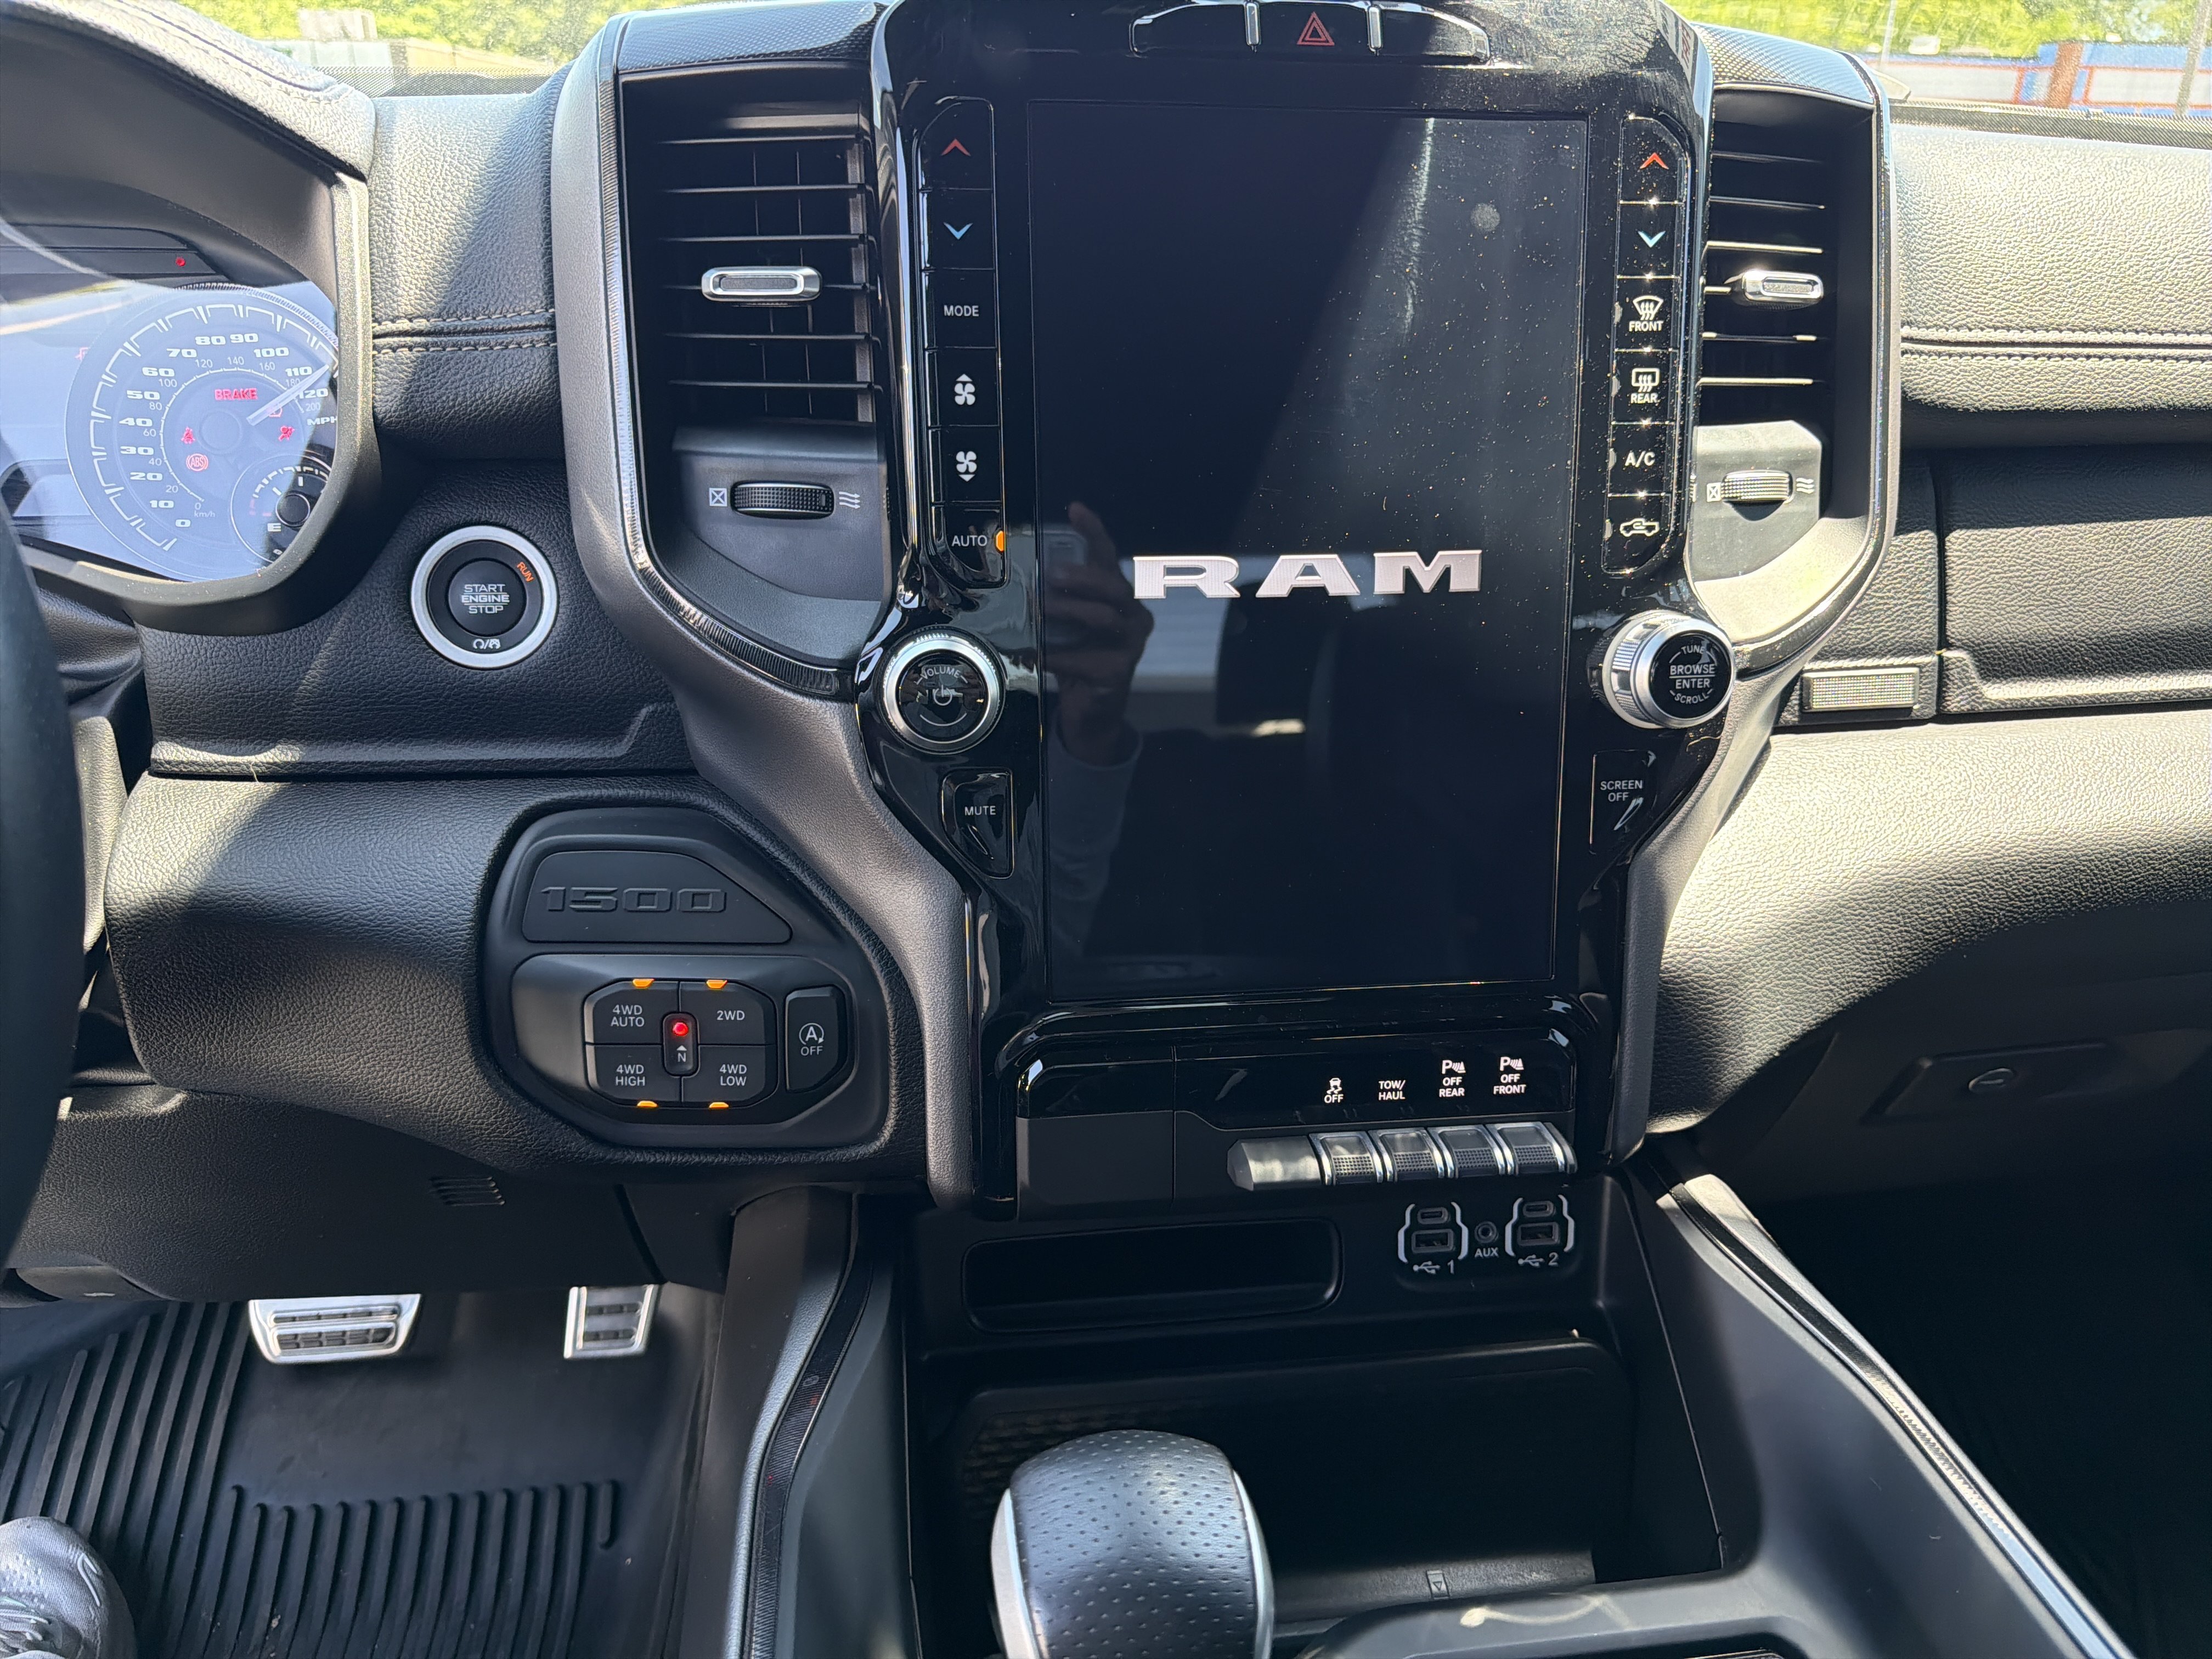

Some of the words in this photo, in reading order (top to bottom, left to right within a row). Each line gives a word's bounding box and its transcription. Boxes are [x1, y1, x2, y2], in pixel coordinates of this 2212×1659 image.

[944, 305, 979, 317] MODE
[1629, 320, 1663, 331] FRONT
[195, 336, 226, 345] 80
[230, 333, 258, 343] 90
[166, 348, 197, 358] 70
[253, 347, 289, 358] 100
[195, 359, 213, 368] 120
[228, 357, 244, 365] 140
[259, 362, 275, 371] 160
[285, 366, 312, 377] 110
[142, 367, 175, 377] 60
[159, 379, 177, 387] 100
[127, 390, 160, 400] 50
[215, 388, 258, 400] BRAKE
[1630, 393, 1658, 404] REAR
[149, 402, 162, 410] 80
[306, 403, 320, 412] 200
[119, 417, 153, 427] 40
[143, 429, 156, 437] 60
[120, 446, 154, 455] 30
[149, 458, 162, 466] 40
[191, 458, 205, 467] ABS
[1625, 451, 1655, 467] A/C
[130, 472, 162, 481] 20
[166, 485, 178, 493] 20
[149, 500, 174, 508] 10
[175, 519, 191, 527] 0
[267, 523, 281, 532] E
[952, 535, 988, 546] AUTO
[517, 562, 535, 582] RUN
[1133, 549, 1482, 599] RAM
[464, 584, 506, 592] START
[461, 594, 510, 603] ENGINE
[469, 605, 504, 614] STOP
[1681, 645, 1705, 654] TUNE
[920, 666, 961, 680] VOLUME
[1670, 664, 1715, 675] BROWSE
[1675, 678, 1710, 689] ENTER
[1674, 692, 1709, 704] SCROLL
[1600, 780, 1643, 791] SCREEN
[1608, 792, 1629, 802] OFF
[964, 806, 996, 816] MUTE
[541, 887, 726, 912] 1500
[613, 1005, 642, 1015] 4WD
[717, 1010, 745, 1020] 2WD
[611, 1017, 645, 1027] AUTO
[801, 1046, 823, 1056] OFF
[678, 1053, 686, 1063] N
[616, 1065, 644, 1075] 4WD
[719, 1064, 747, 1075] 4WD
[615, 1076, 645, 1086] HIGH
[720, 1076, 746, 1086] LOW
[1443, 1077, 1463, 1086] OFF
[1500, 1074, 1521, 1084] OFF
[1379, 1080, 1406, 1090] TOW/
[1493, 1084, 1526, 1095] FRONT
[1379, 1091, 1405, 1101] HAUL
[1439, 1088, 1465, 1098] REAR
[1324, 1094, 1344, 1104] OFF
[1475, 1248, 1499, 1257] AUX
[1548, 1252, 1559, 1267] 2
[1447, 1260, 1455, 1274] 1
